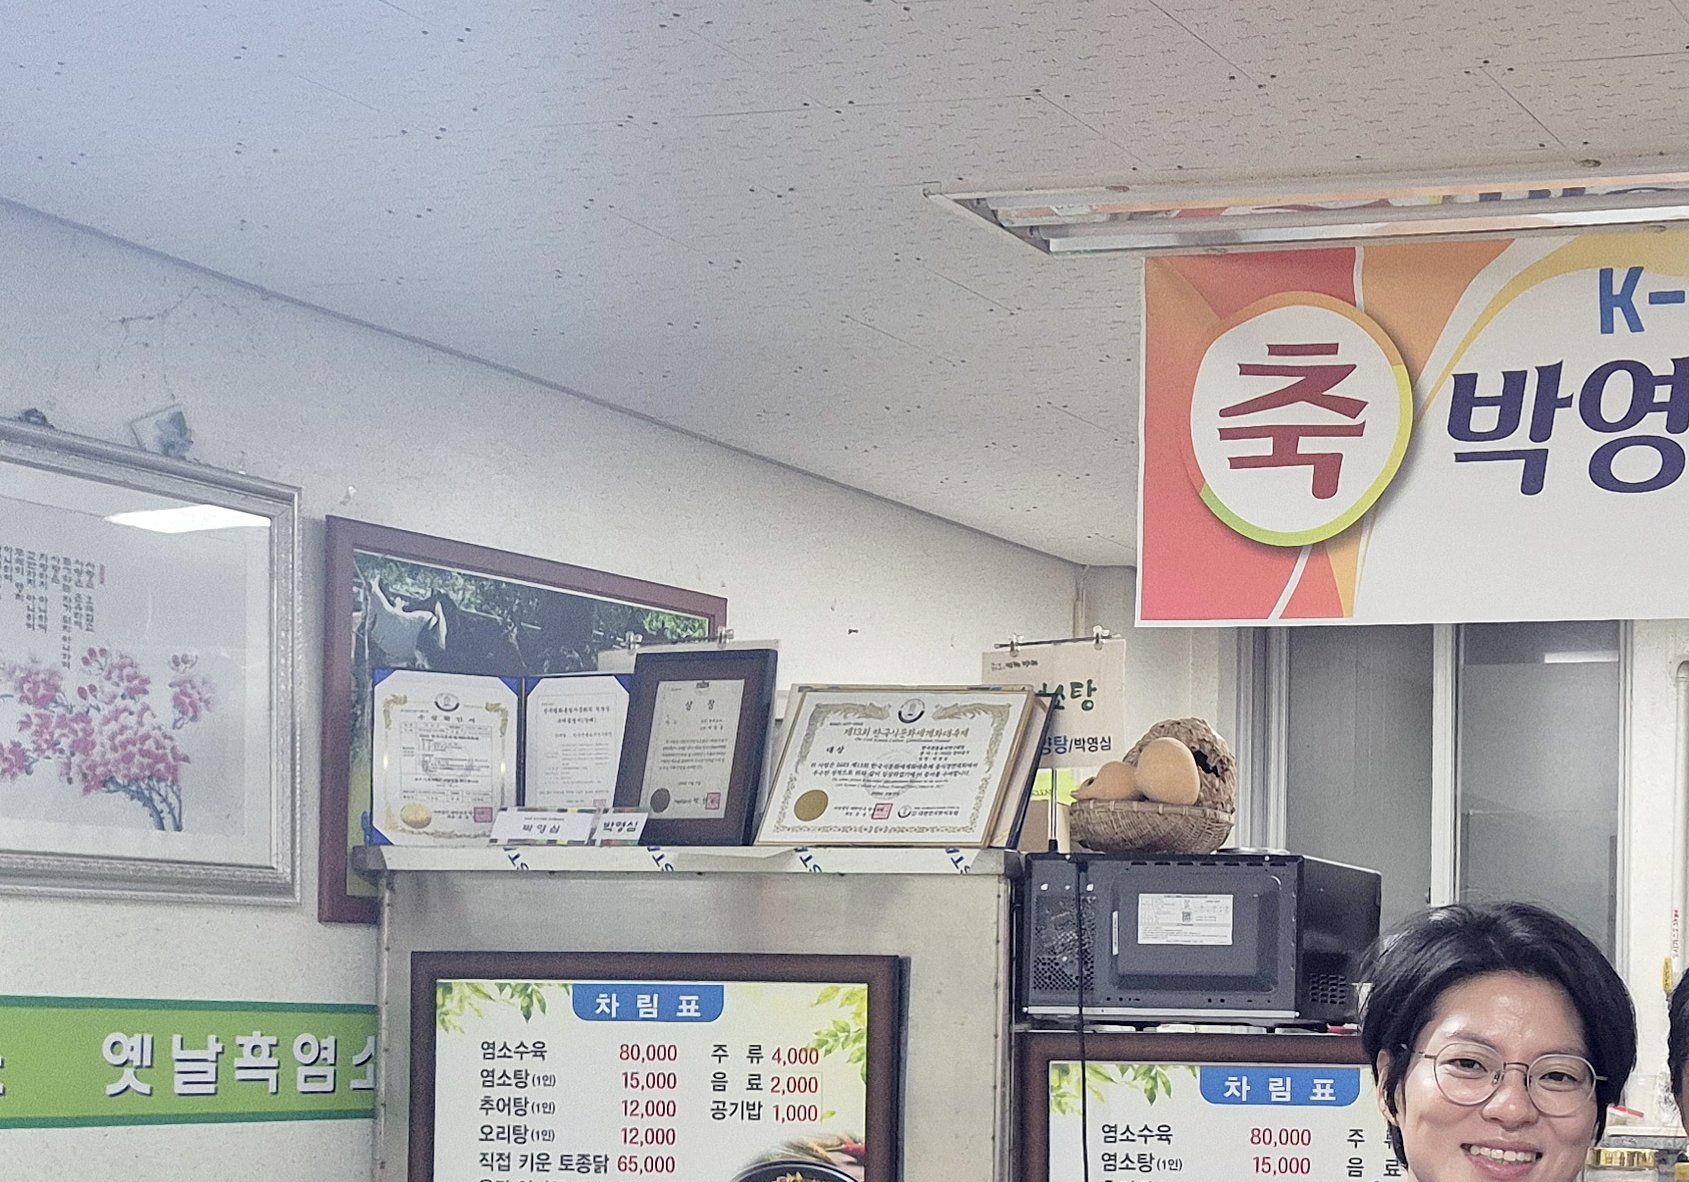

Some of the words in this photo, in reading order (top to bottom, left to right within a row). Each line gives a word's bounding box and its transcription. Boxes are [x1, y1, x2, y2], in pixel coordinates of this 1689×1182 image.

[1218, 342, 1370, 501] 축
[1039, 679, 1098, 711] 소탕
[480, 1041, 547, 1062] 염소수육
[619, 1043, 678, 1064] 80,000
[771, 1047, 820, 1067] 4,000
[621, 1071, 677, 1092] 15,000
[770, 1075, 819, 1097] 2,000
[621, 1099, 677, 1120] 12,000
[710, 1100, 763, 1122] 공기밥
[772, 1104, 819, 1124] 1,000
[621, 1127, 676, 1148] 12,000
[1101, 1124, 1173, 1145] 염소수육
[1250, 1128, 1312, 1147] 80,000
[479, 1152, 511, 1173] 직접
[519, 1153, 551, 1174] 키운
[558, 1154, 609, 1175] 토종닭
[617, 1155, 676, 1176] 65,000
[1253, 1156, 1311, 1176] 15,000
